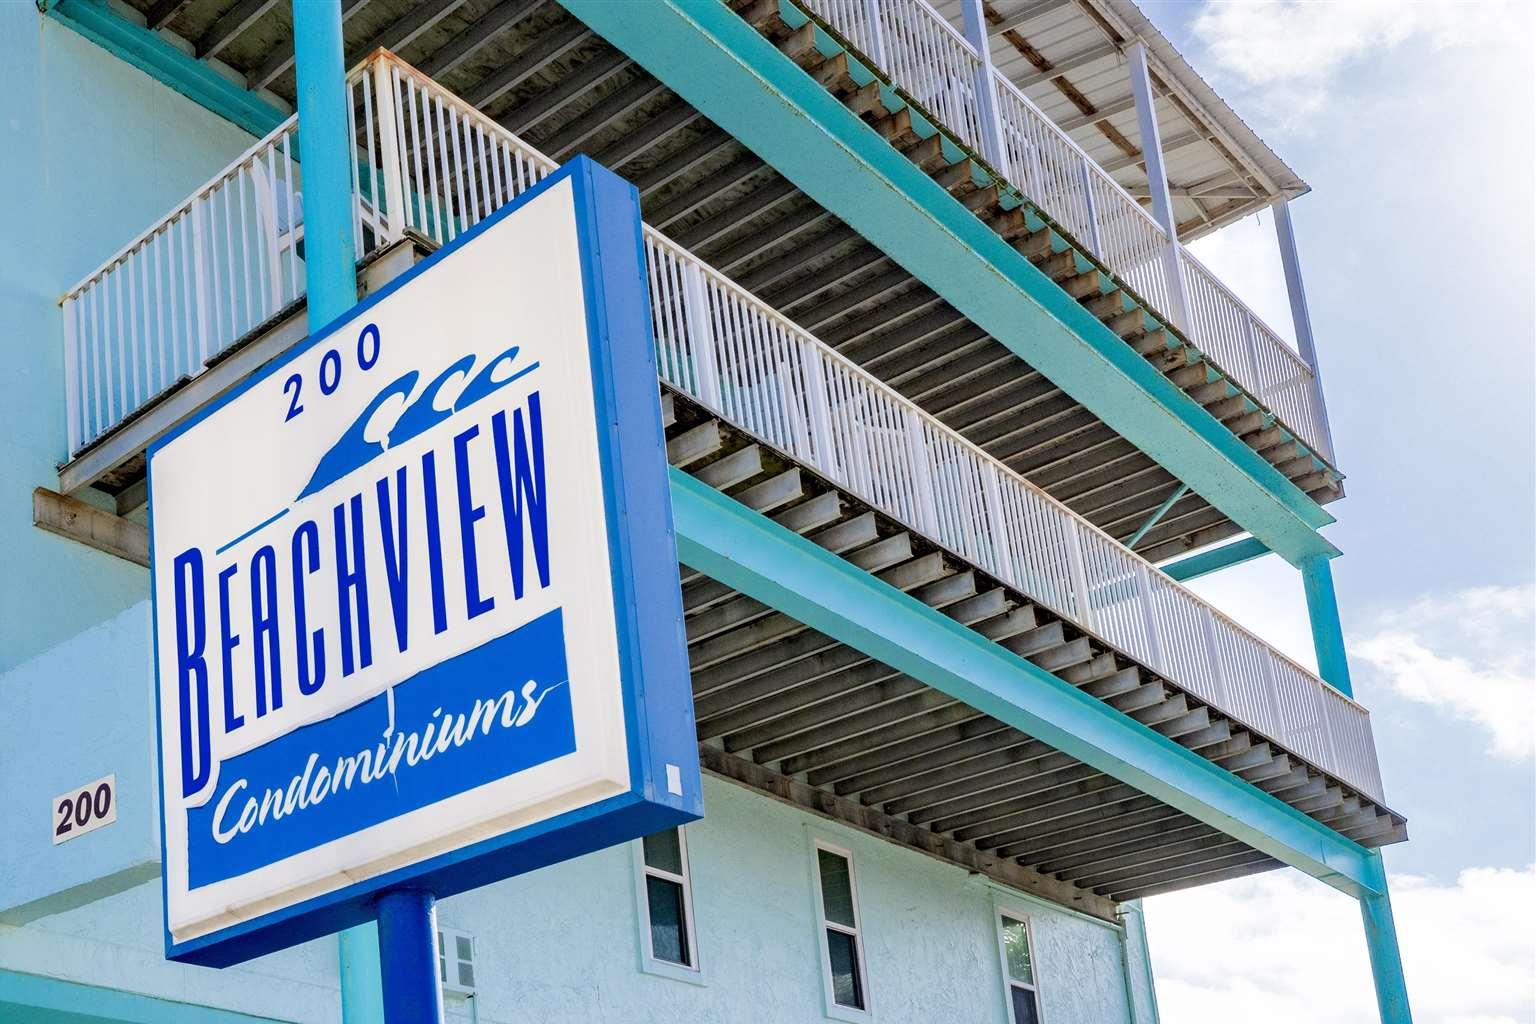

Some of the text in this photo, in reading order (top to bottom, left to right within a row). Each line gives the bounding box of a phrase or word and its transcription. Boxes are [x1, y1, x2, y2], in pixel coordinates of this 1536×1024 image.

[283, 323, 381, 423] 200
[174, 390, 552, 799] BEACHVIEW
[56, 783, 111, 836] 200
[211, 678, 546, 844] Condominiums
